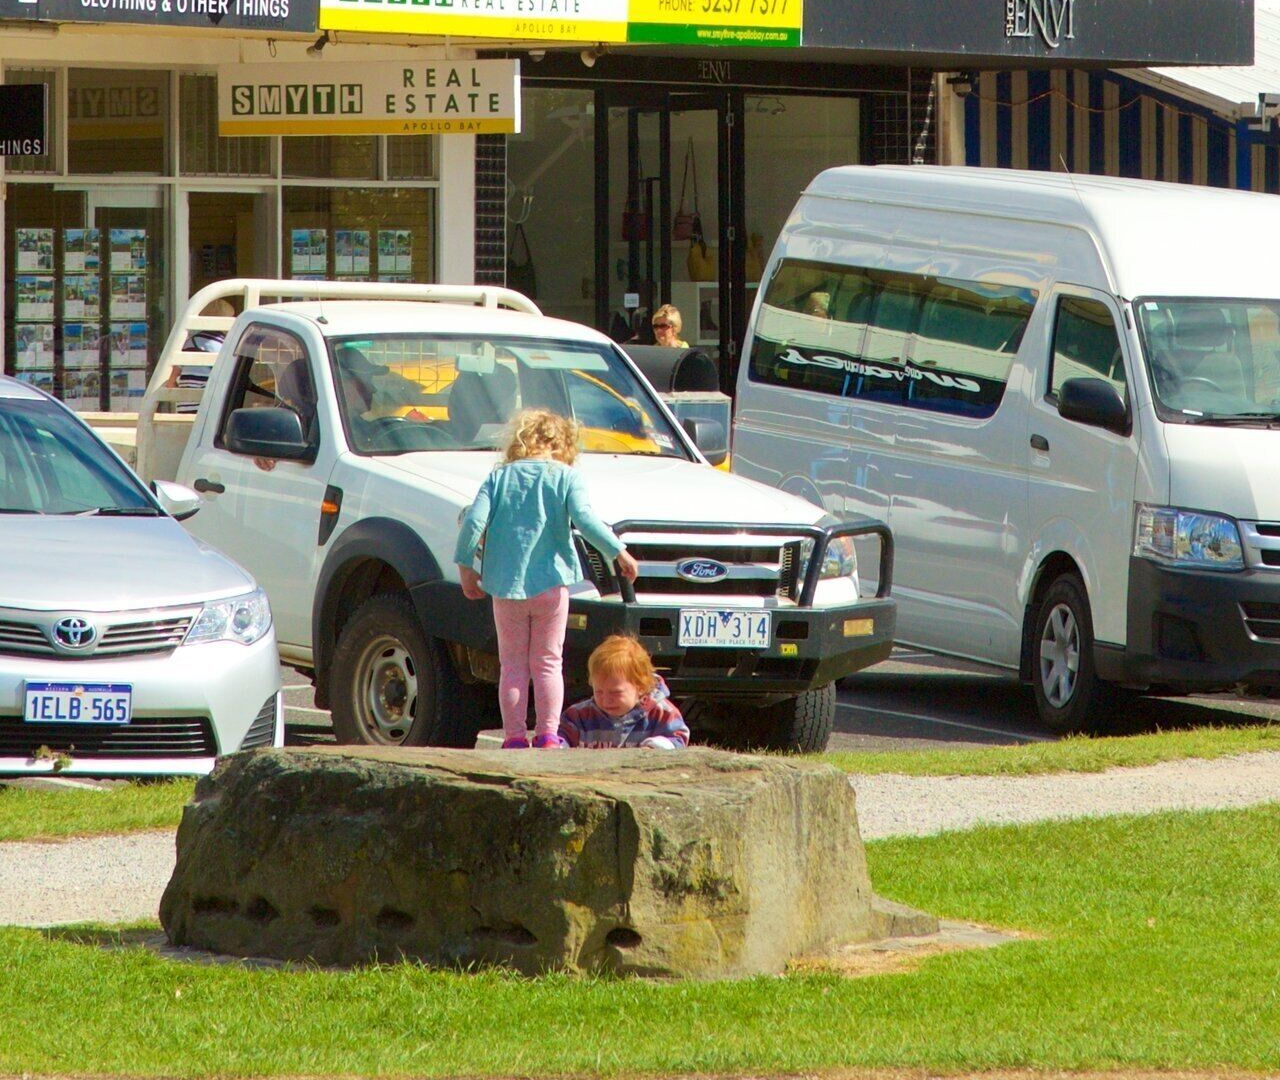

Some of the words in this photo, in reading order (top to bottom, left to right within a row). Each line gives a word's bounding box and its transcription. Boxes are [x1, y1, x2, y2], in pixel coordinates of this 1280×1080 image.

[515, 23, 554, 34] APOLLO
[560, 24, 578, 34] BAY
[403, 67, 481, 88] REAL
[232, 84, 363, 115] SMYTH
[386, 93, 500, 114] ESTATE
[403, 122, 452, 131] APOLLO
[459, 121, 482, 131] BAY
[691, 562, 717, 576] Ford
[683, 615, 717, 638] XDH
[732, 617, 767, 639] 314
